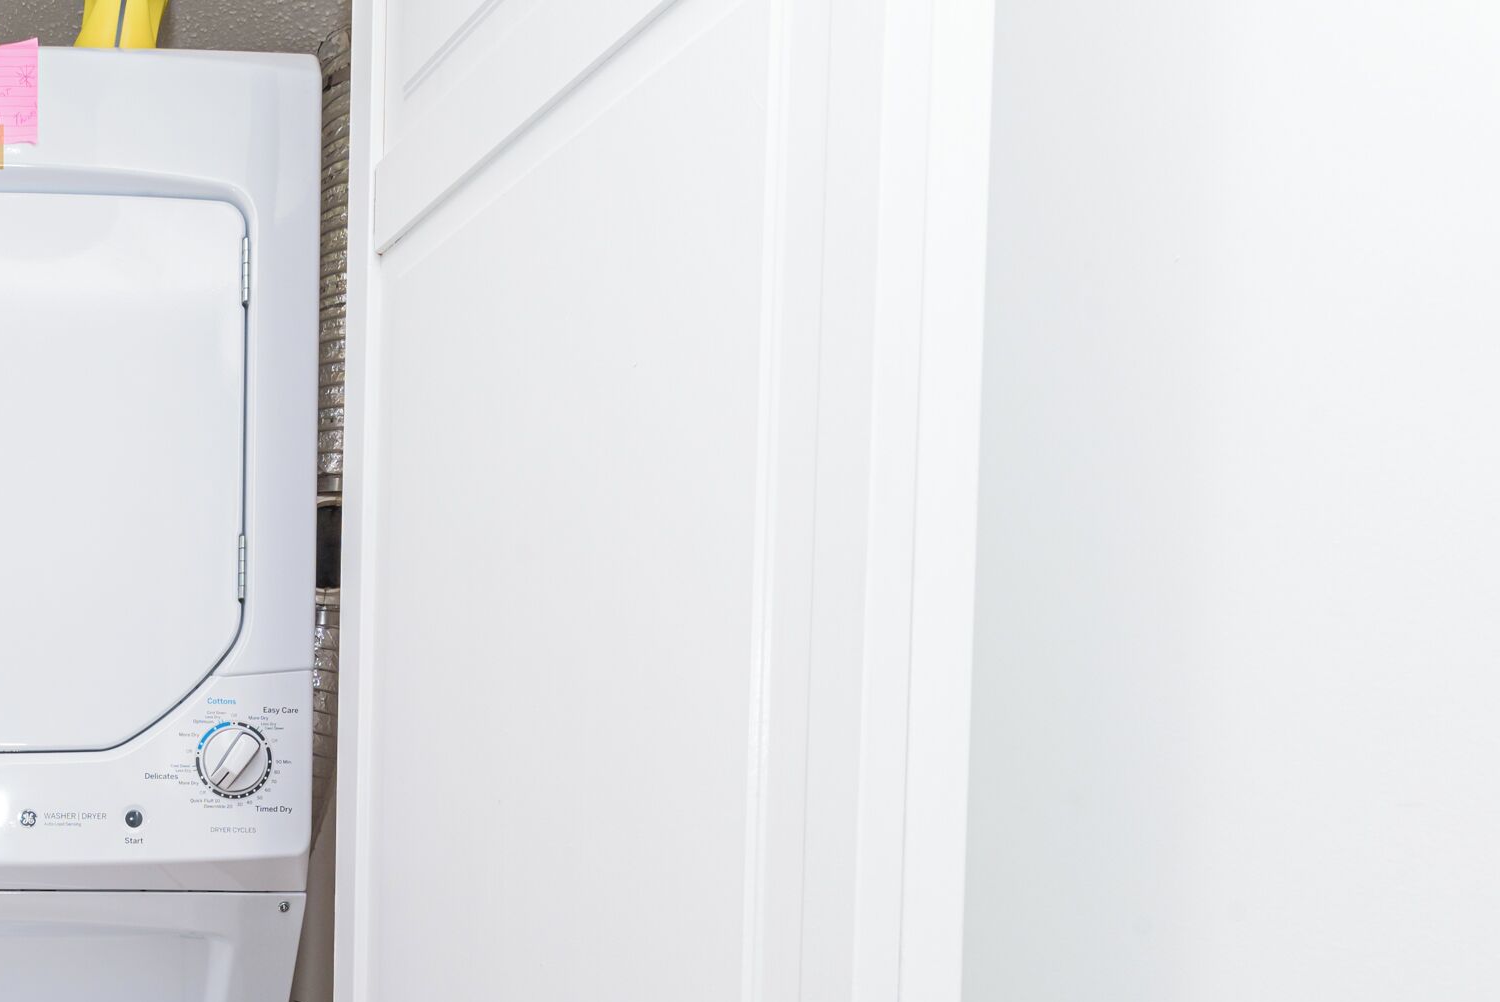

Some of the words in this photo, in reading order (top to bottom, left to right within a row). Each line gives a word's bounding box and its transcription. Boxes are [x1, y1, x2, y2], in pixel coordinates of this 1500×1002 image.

[207, 697, 237, 705] Cottons
[263, 706, 280, 715] Easy
[281, 706, 299, 714] Care
[144, 772, 179, 780] Delicates
[256, 805, 278, 813] Timed
[279, 805, 293, 814] Dry
[43, 812, 77, 820] WASHER
[81, 812, 107, 820] DRYER
